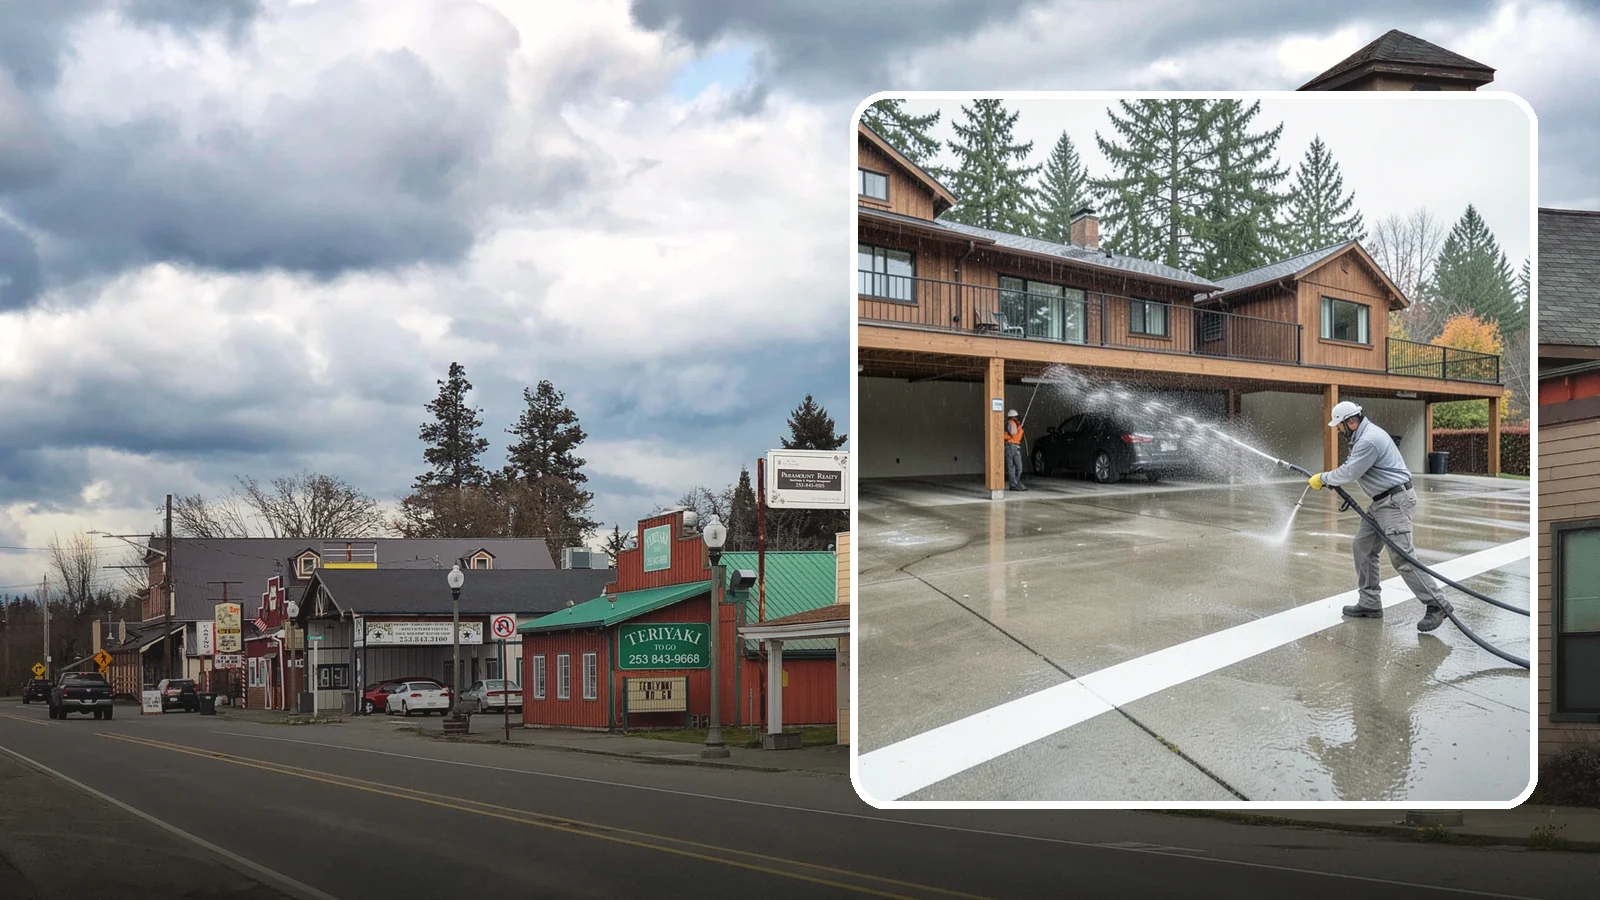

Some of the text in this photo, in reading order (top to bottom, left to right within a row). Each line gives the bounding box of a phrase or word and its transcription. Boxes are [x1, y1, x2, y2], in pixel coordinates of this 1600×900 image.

[781, 471, 815, 479] PARAMOUNT
[625, 627, 702, 646] TERIYAKI
[629, 654, 700, 664] 253 843-9668
[639, 681, 673, 691] TERIYAKI
